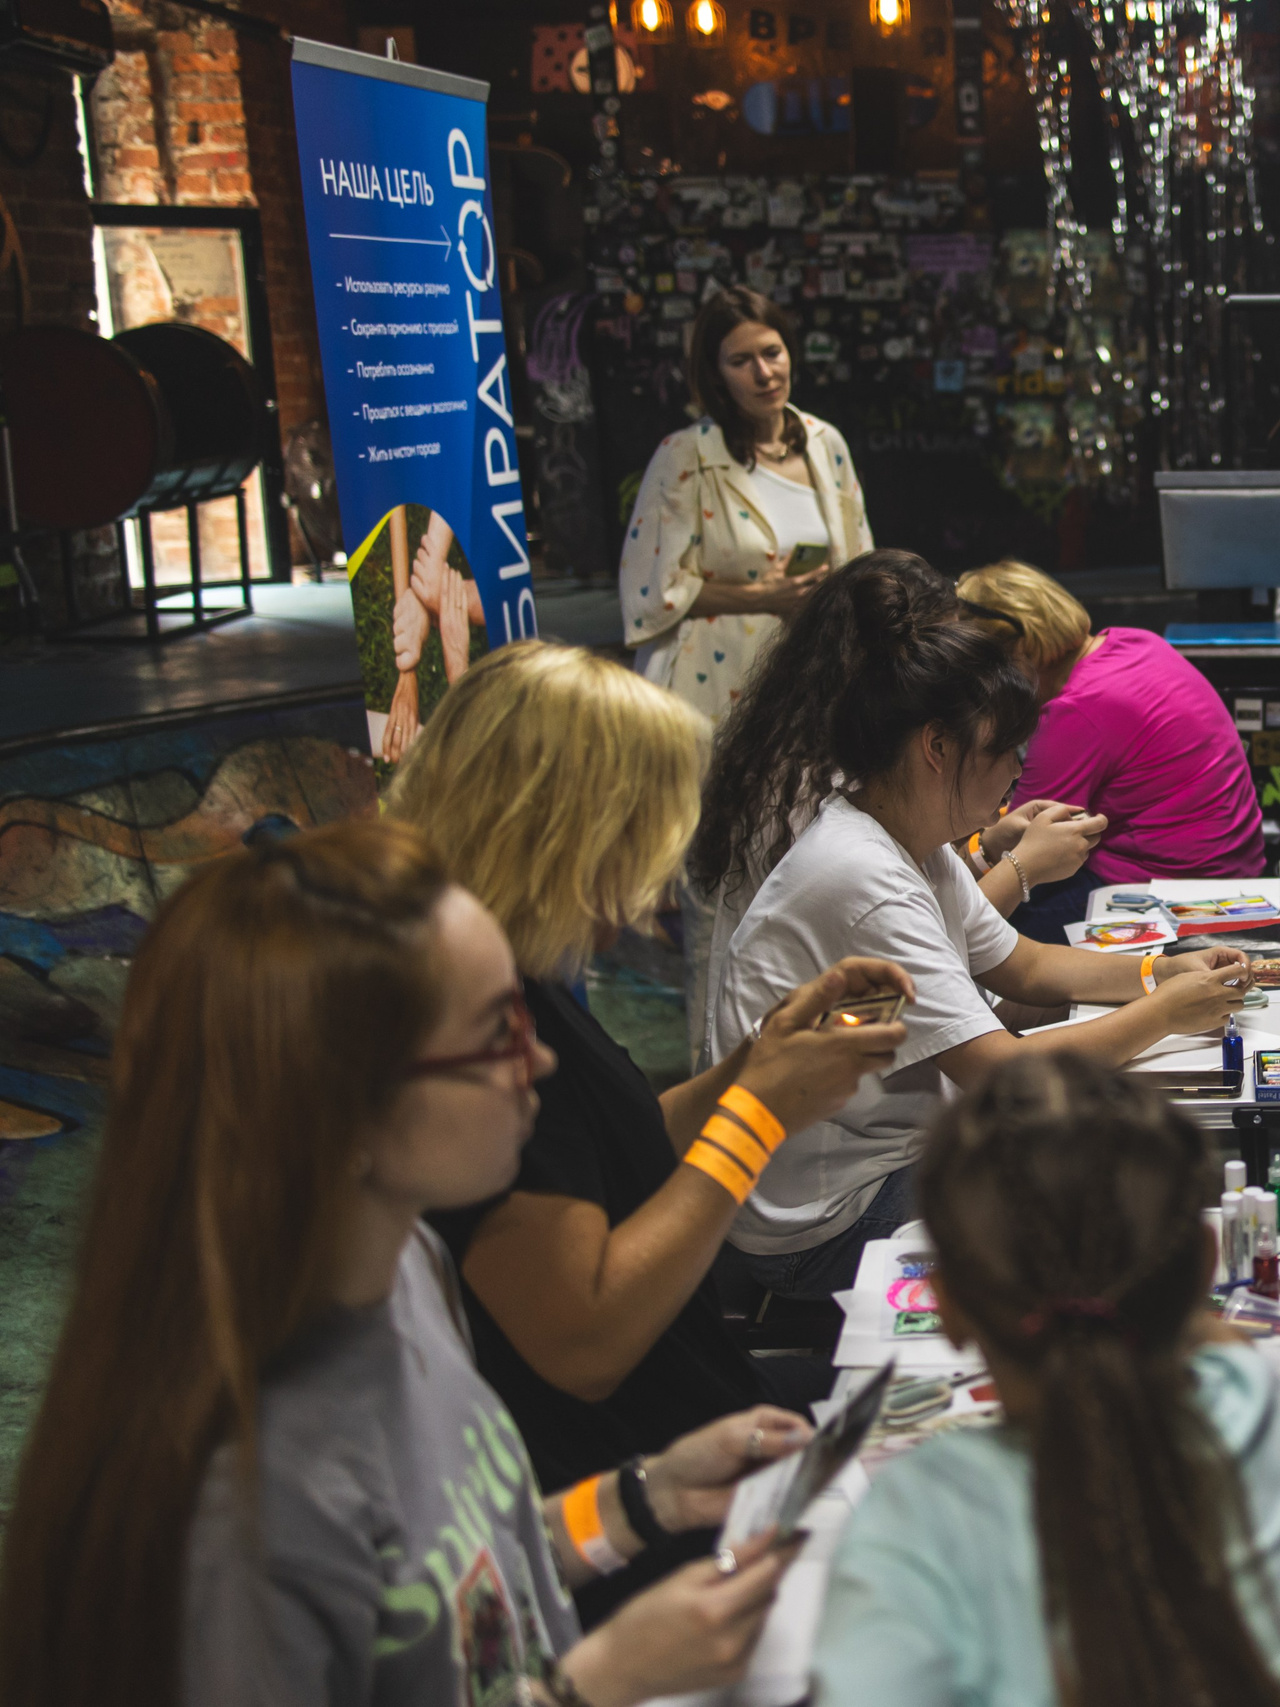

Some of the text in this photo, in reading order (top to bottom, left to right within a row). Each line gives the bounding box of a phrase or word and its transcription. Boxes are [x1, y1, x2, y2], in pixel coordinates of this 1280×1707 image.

[320, 158, 434, 209] НАША ЦЕЛЬ
[1258, 1092, 1277, 1100] Pastel
